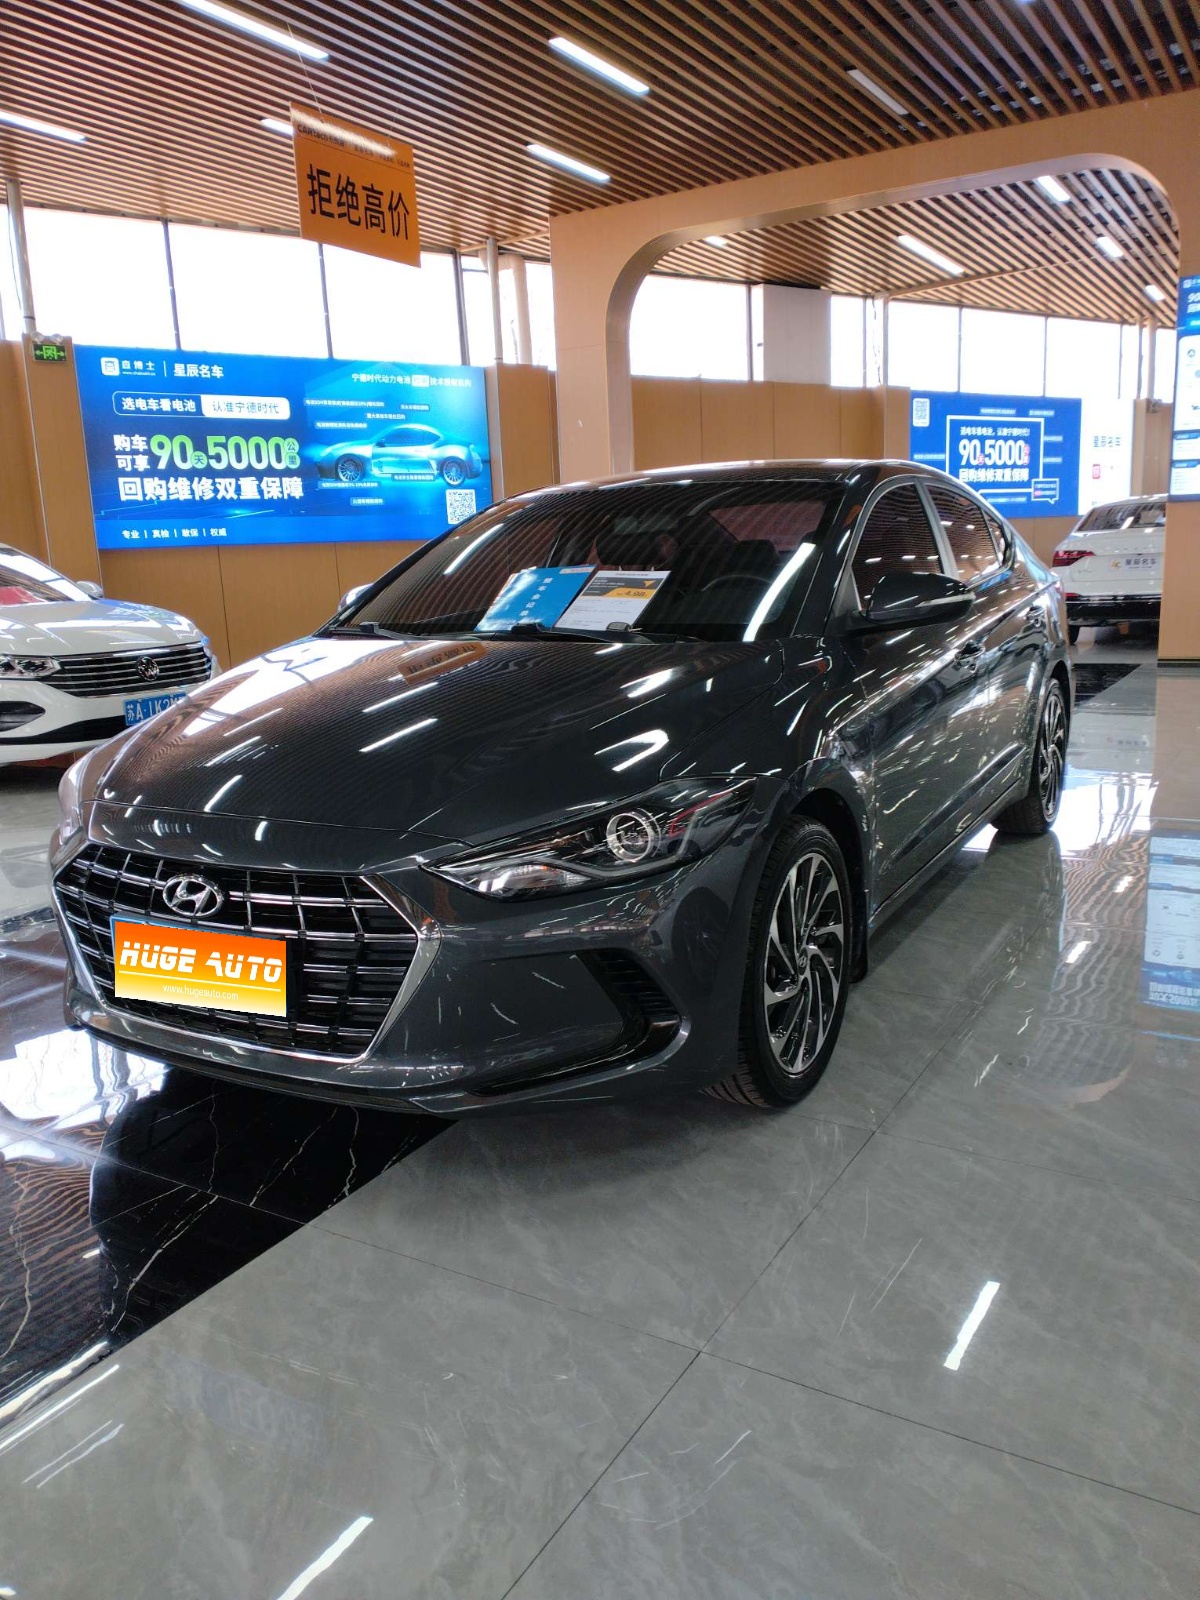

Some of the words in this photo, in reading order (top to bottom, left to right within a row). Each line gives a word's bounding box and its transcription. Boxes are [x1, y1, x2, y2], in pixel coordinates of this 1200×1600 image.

[307, 164, 409, 240] 拒绝高价
[174, 363, 224, 379] 星辰名车
[122, 397, 196, 412] 选电车看电池
[212, 401, 280, 414] 认准宁德时代
[113, 434, 147, 452] 购车
[115, 454, 150, 472] 可享
[118, 476, 304, 501] 回购维修双重保障
